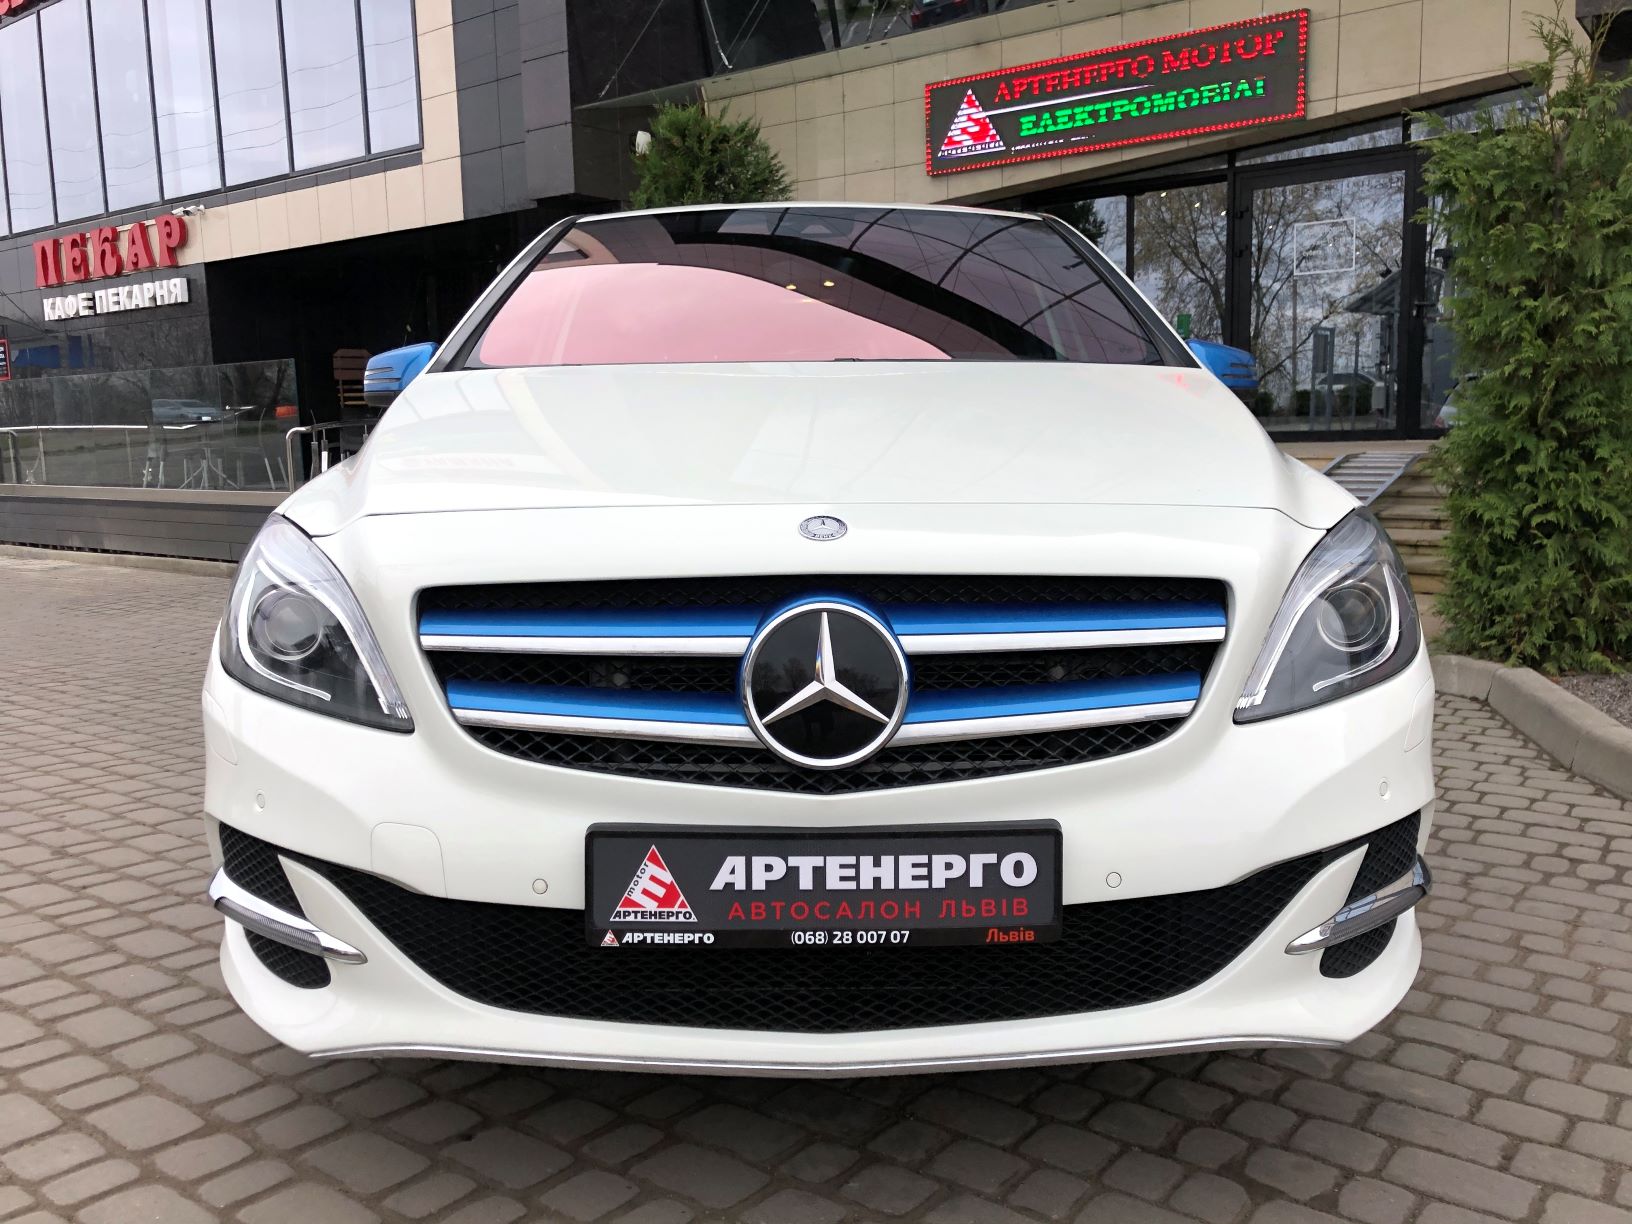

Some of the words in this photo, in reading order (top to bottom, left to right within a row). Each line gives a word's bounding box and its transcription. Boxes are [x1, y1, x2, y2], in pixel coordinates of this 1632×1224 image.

[32, 214, 188, 288] ПЕКАР
[42, 292, 95, 321] КАФЕ
[95, 278, 189, 314] ПЕКАРНЯ
[626, 861, 650, 898] motor
[709, 851, 1038, 891] АРТЕНЕРГО
[727, 900, 921, 921] АВТОСАЛОН
[938, 898, 1029, 918] ЛЬВІВ
[621, 932, 715, 945] АРТЕНЕРГО
[790, 930, 829, 945] (068)
[832, 931, 853, 944] 28
[856, 931, 888, 944] 007
[890, 930, 910, 944] 07
[985, 927, 1035, 944] Львів
